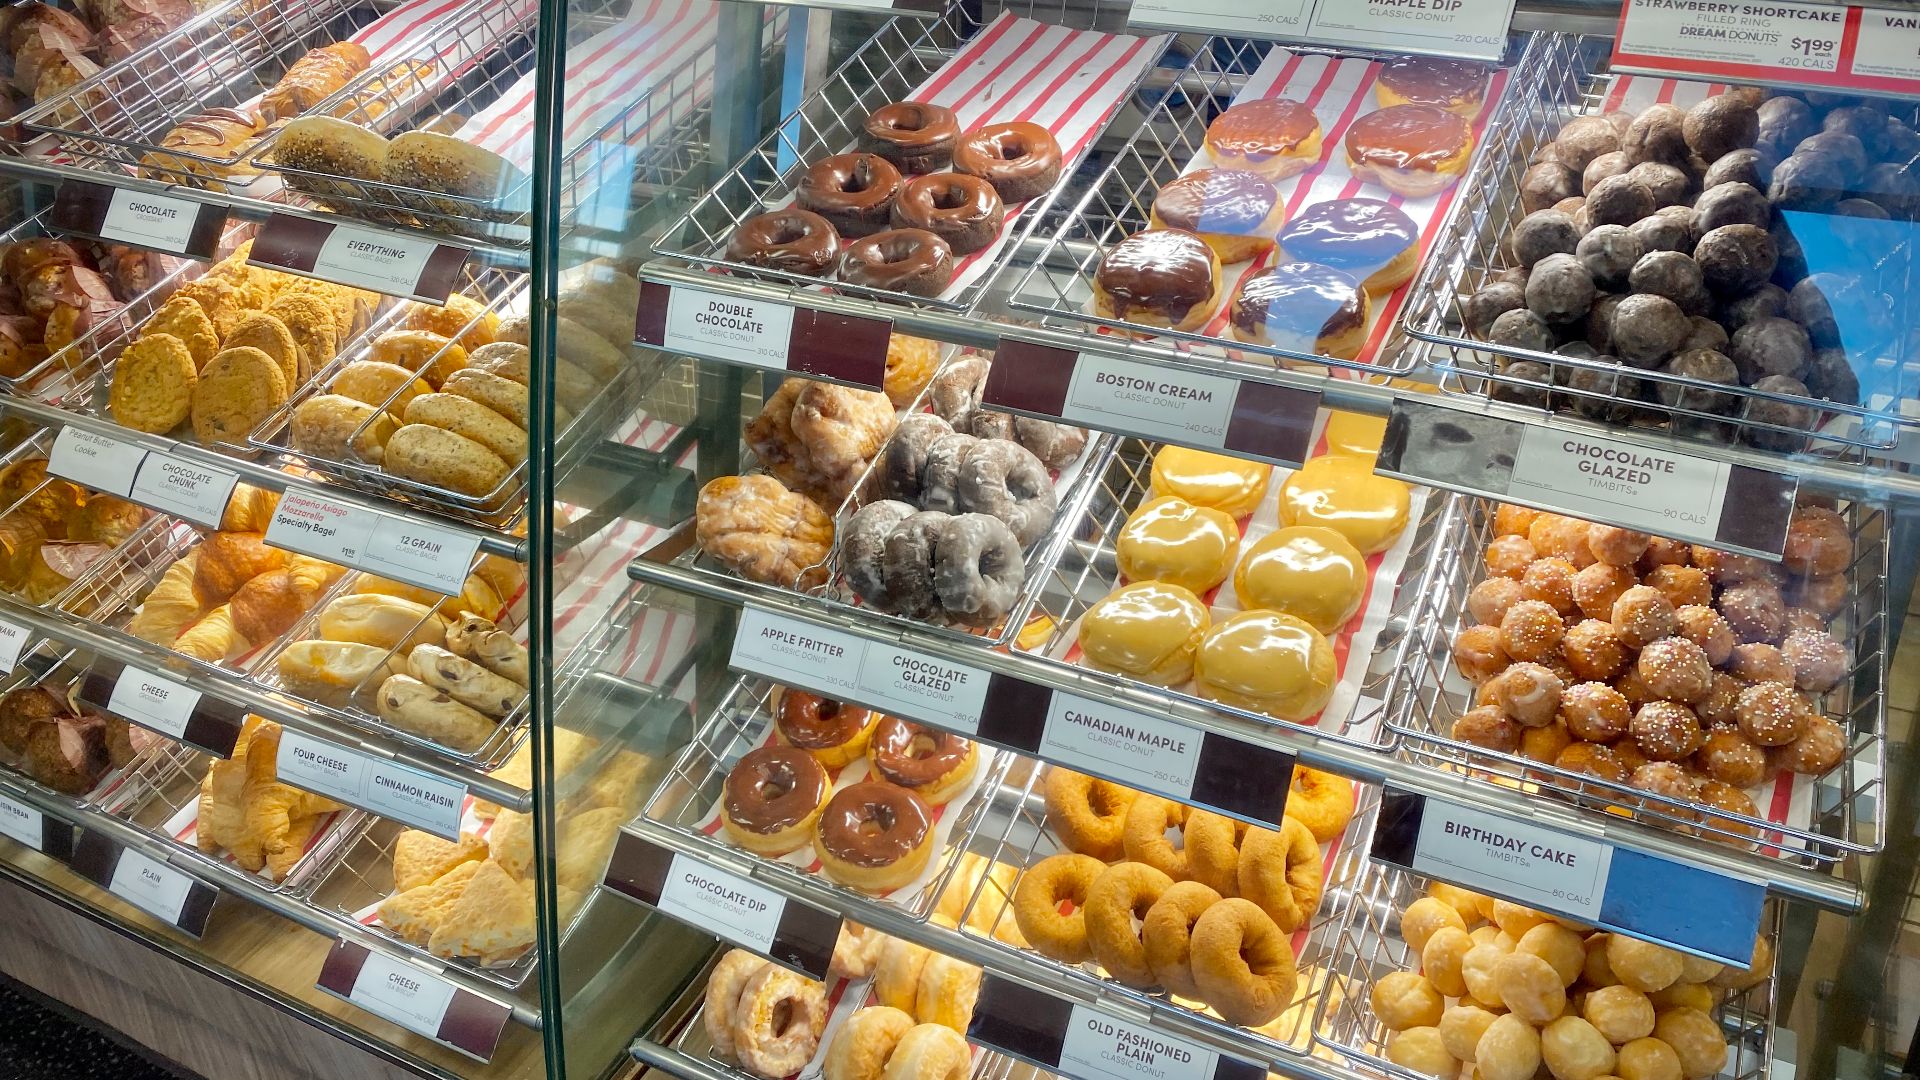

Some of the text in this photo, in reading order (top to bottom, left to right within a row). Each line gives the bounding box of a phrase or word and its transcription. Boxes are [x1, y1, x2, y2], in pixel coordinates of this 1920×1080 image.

[1368, 7, 1455, 22] CLASSIC DONUT
[1432, 0, 1462, 11] DIP
[1635, 0, 1841, 22] STRAWBERRY SHORTCAKE
[1257, 14, 1299, 25] 250 CALS
[1696, 13, 1771, 28] FILLED RING
[1454, 34, 1500, 45] 220 CALS
[1679, 26, 1726, 39] DREAM
[1778, 57, 1834, 70] 420 CALS
[129, 202, 177, 219] CHOCOLATE
[347, 240, 406, 259] EVERYTHING
[708, 301, 754, 318] DOUBLE
[695, 312, 764, 334] CHOCOLATE
[700, 327, 729, 339] CLASSIC
[729, 333, 755, 343] DONUT
[768, 349, 785, 359] CALS
[1095, 372, 1213, 403] BOSTON CREAM
[1114, 390, 1187, 410] CLASSIC DONUT
[69, 428, 115, 449] Peanut Butter
[1184, 422, 1224, 437] 240 CALS
[74, 444, 97, 458] Cookie
[1562, 440, 1676, 474] CHOCOLATE
[162, 463, 212, 485] CHOCOLATE
[1578, 460, 1652, 485] GLAZED
[168, 475, 197, 490] CHUNK
[281, 504, 325, 522] Mozzarella
[320, 503, 348, 517] Asiago
[1663, 508, 1706, 525] 90 CALS
[276, 514, 336, 537] Specialty Bagel
[400, 535, 443, 553] 12 GRAIN
[395, 545, 419, 557] CLASSIC
[420, 552, 438, 562] BAGEL
[760, 627, 844, 658] APPLE FRITTER
[771, 643, 801, 657] CLASSIC
[801, 651, 828, 664] DONUT
[893, 655, 968, 684] CHOCOLATE
[838, 679, 856, 690] CALS
[902, 670, 951, 692] GLAZED
[141, 683, 170, 700] CHEESE
[893, 680, 925, 695] CLASSIC
[926, 689, 954, 703] DONUT
[952, 711, 967, 721] 280
[1064, 710, 1186, 754] CANADIAN MAPLE
[1087, 731, 1122, 748] CLASSIC
[1123, 742, 1156, 758] DONUT
[293, 747, 348, 773] FOUR CHEESE
[1153, 770, 1190, 787] 250 CALS
[375, 775, 454, 808] CINNAMON RAISIN
[1444, 820, 1577, 868] BIRTHDAY CAKE
[142, 868, 162, 883] PLAIN
[685, 873, 747, 906] CHOCOLATE
[748, 899, 767, 913] DIP
[1552, 888, 1592, 906] 80 CALS
[696, 891, 722, 907] CLASSIC
[723, 902, 747, 917] DONUT
[755, 933, 770, 945] CALS
[388, 973, 421, 992] CHEESE
[1087, 1019, 1114, 1037] OLD
[1116, 1029, 1192, 1064] FASHIONED
[1116, 1043, 1155, 1066] PLAIN
[1100, 1050, 1135, 1068] CLASSIC
[1135, 1062, 1166, 1079] DONUT
